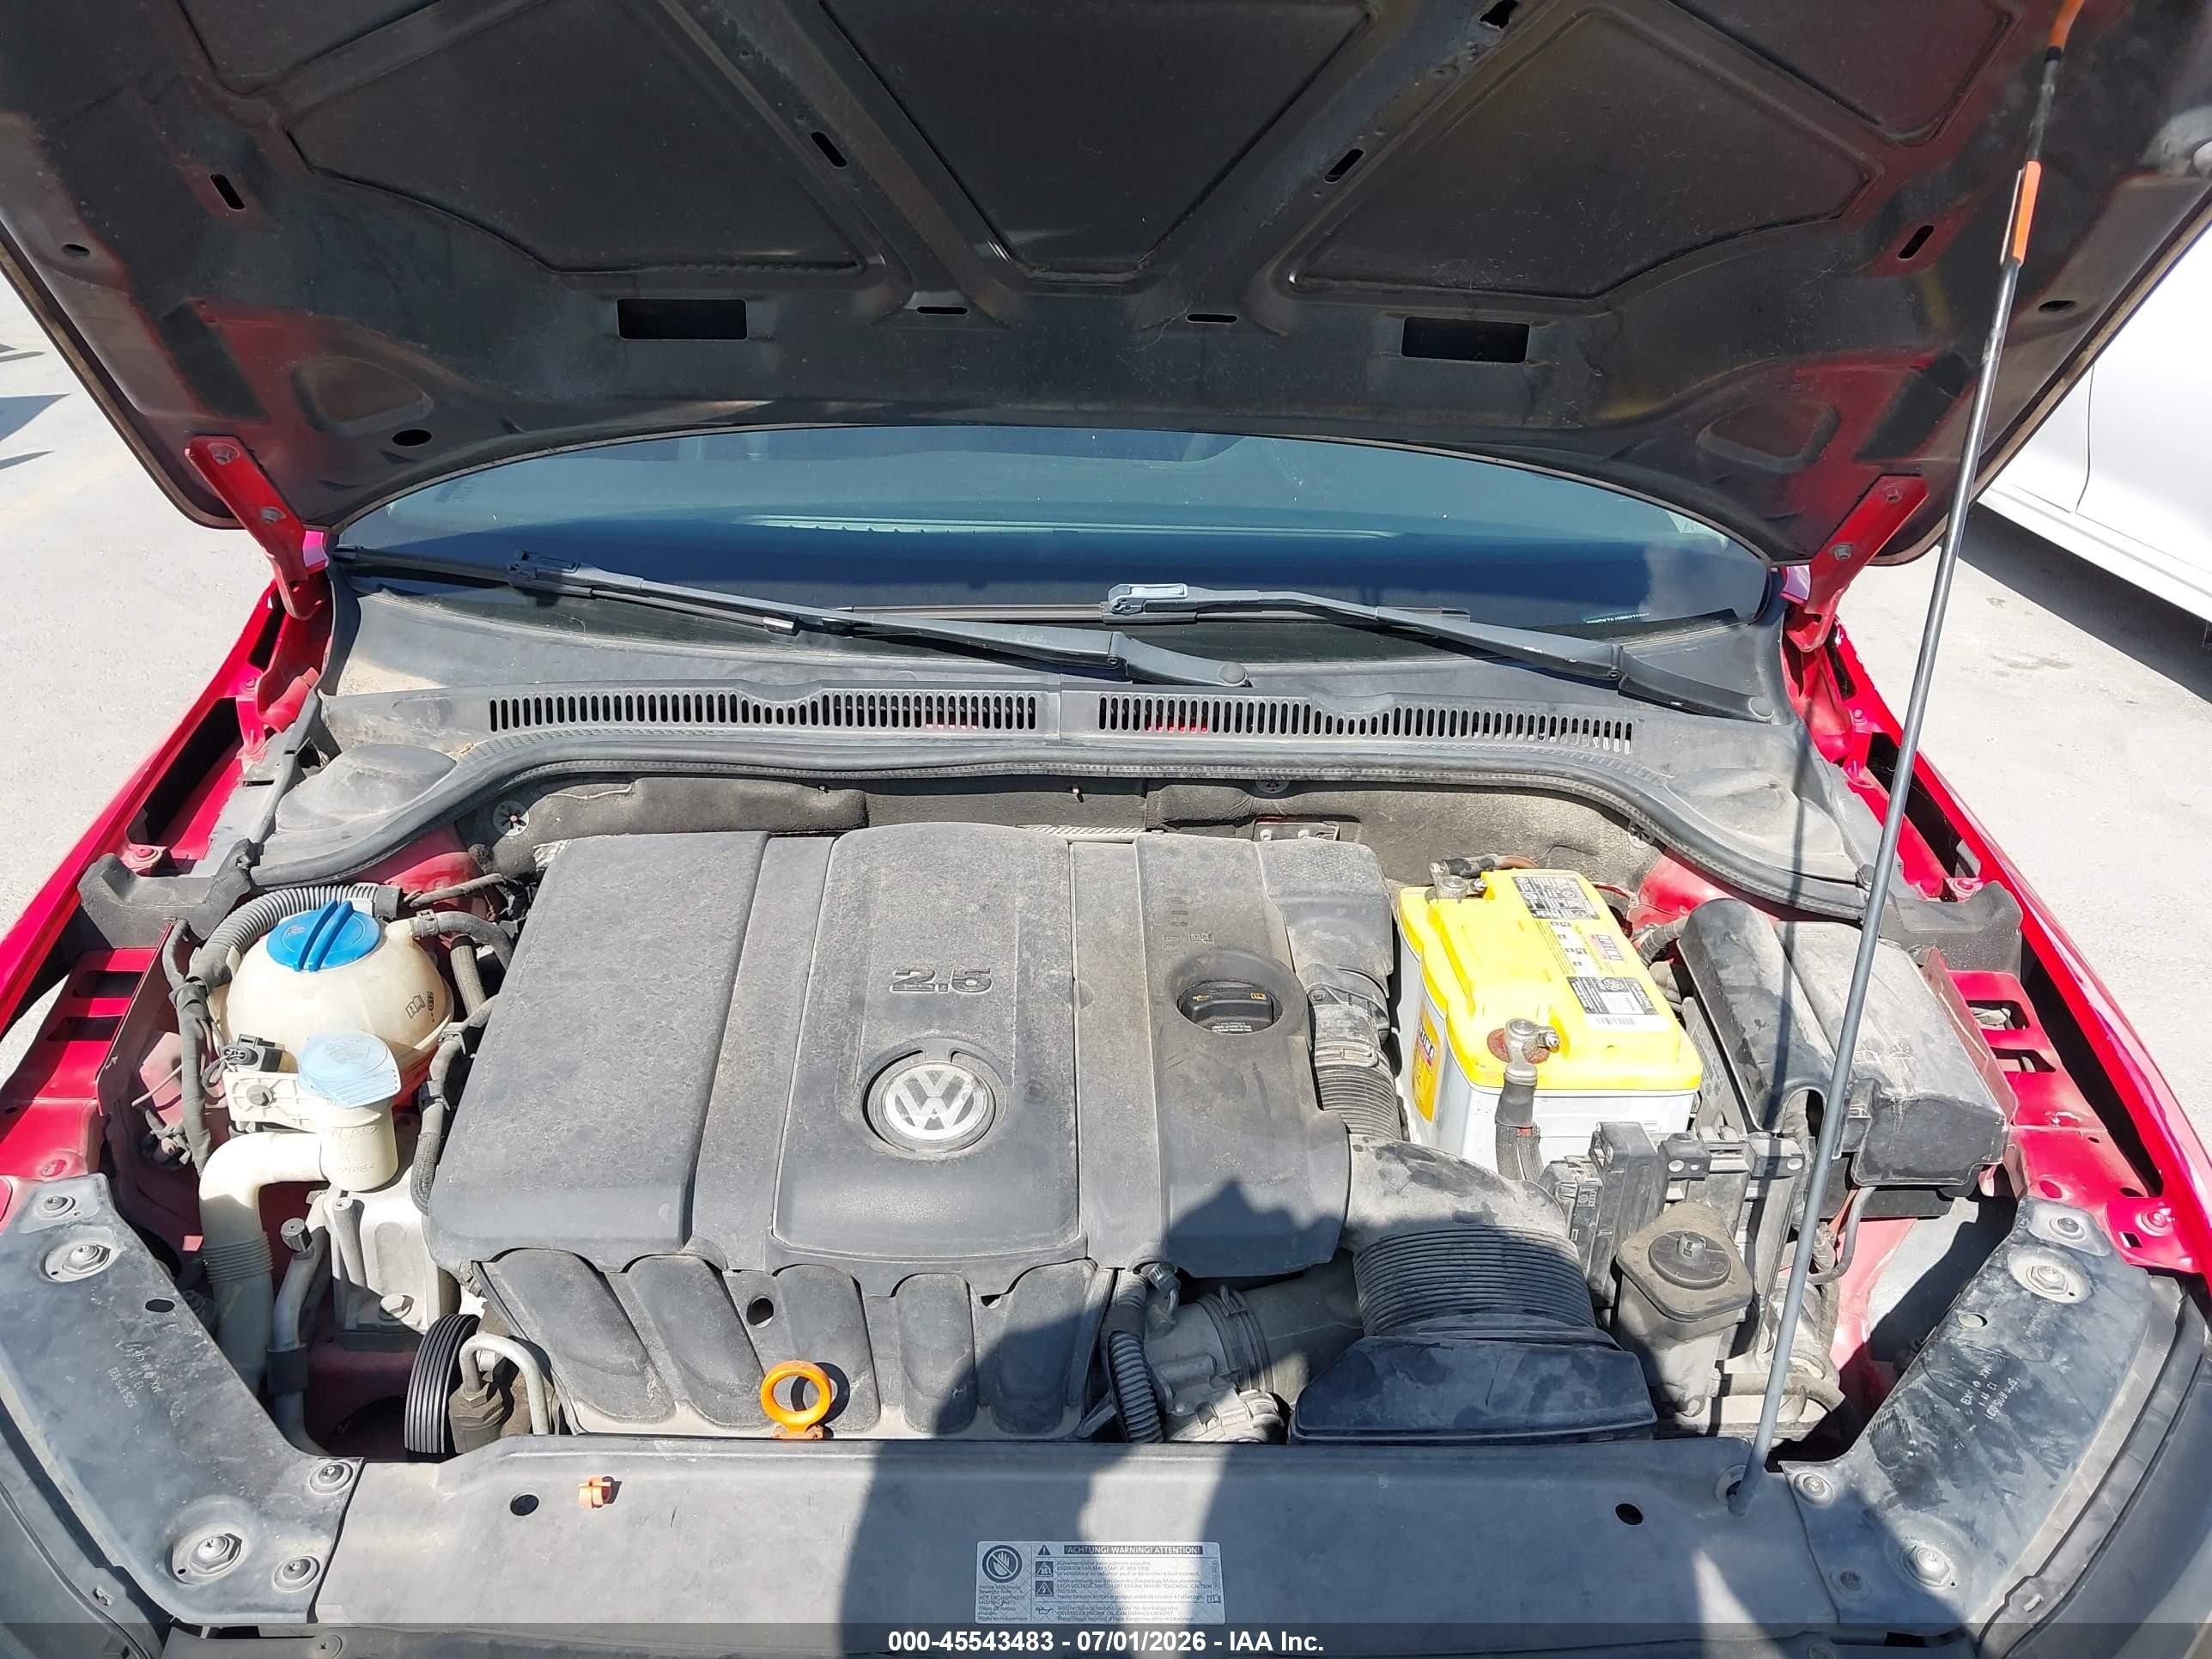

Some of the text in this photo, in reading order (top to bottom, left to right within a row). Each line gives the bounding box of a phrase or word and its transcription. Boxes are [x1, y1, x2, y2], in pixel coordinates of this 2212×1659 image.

[890, 968, 992, 993] 2.5
[1067, 1546, 1200, 1554] ACHTUNG! WARNING! ATTENTION!
